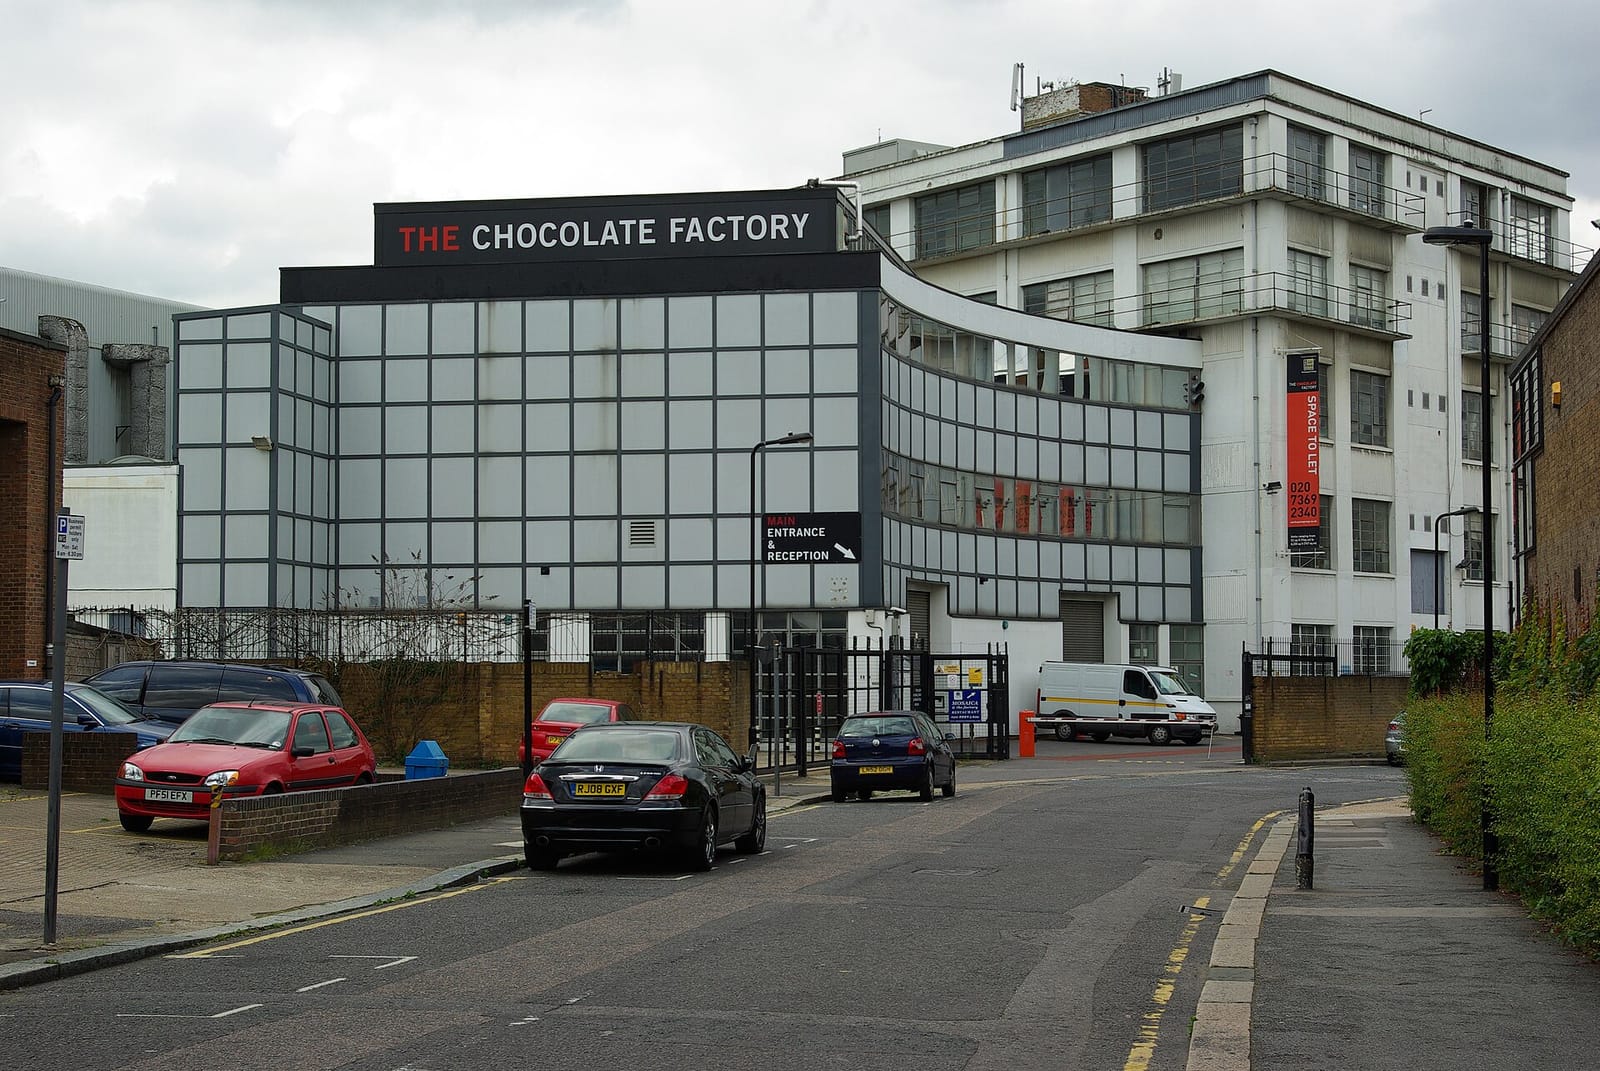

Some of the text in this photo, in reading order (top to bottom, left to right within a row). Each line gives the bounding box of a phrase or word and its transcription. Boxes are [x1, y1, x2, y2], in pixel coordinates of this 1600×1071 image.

[399, 213, 810, 252] THE CHOCOLATE FACTORY
[1307, 395, 1318, 475] SPACE TO LET
[1290, 481, 1310, 493] 020
[1290, 494, 1317, 505] 7369
[1290, 506, 1317, 518] 2340
[60, 518, 67, 532] P
[767, 515, 796, 526] MAIN
[767, 527, 826, 537] ENTRANCE
[767, 540, 775, 549] &
[767, 551, 829, 560] RECEPTION
[577, 784, 623, 794] RJ08 GXF
[150, 789, 187, 801] PF51 EFX
